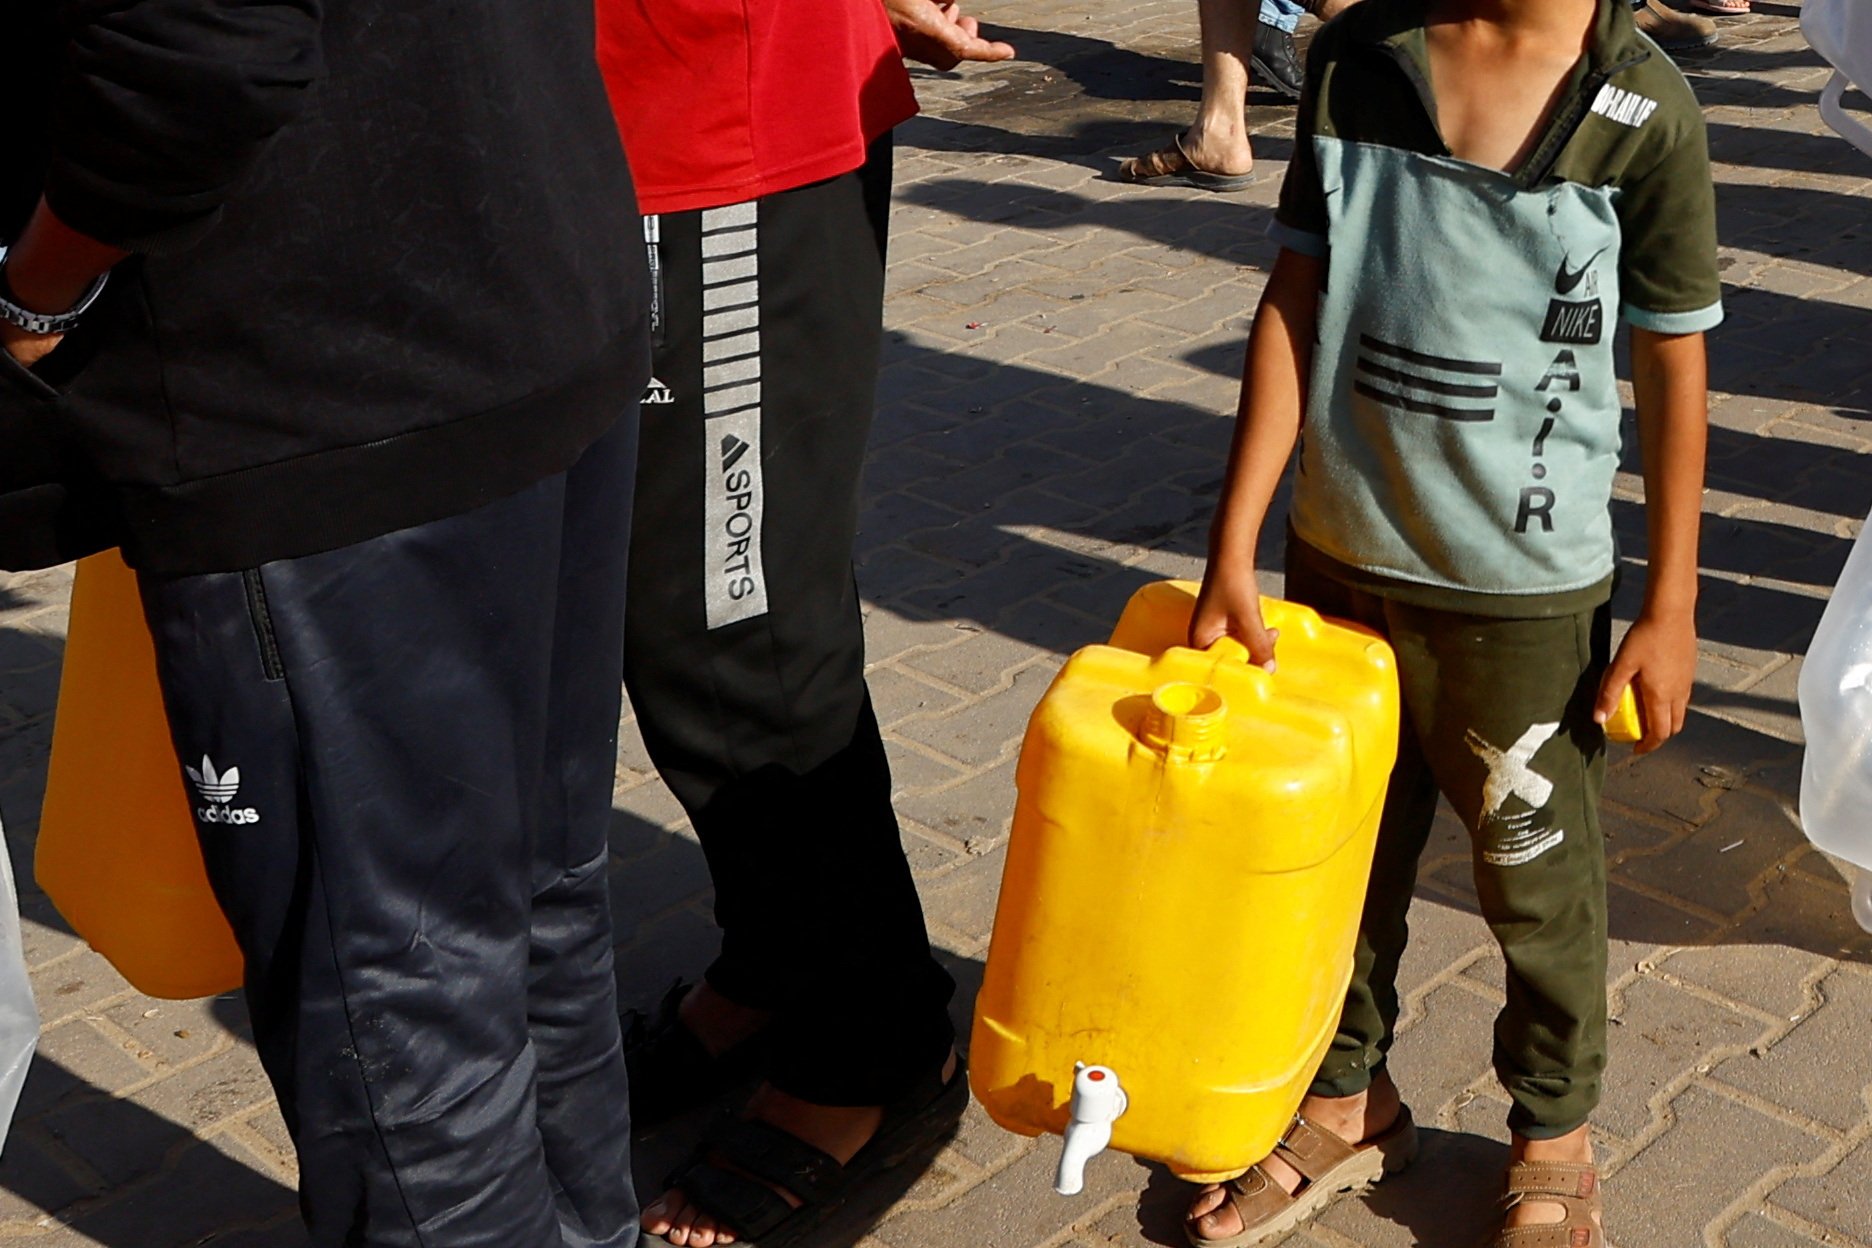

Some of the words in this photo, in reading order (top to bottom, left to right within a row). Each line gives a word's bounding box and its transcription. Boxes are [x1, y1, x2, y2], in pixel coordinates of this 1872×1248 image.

[1550, 304, 1599, 338] NIKE
[724, 469, 754, 602] SPORTS
[197, 804, 260, 825] adidas
